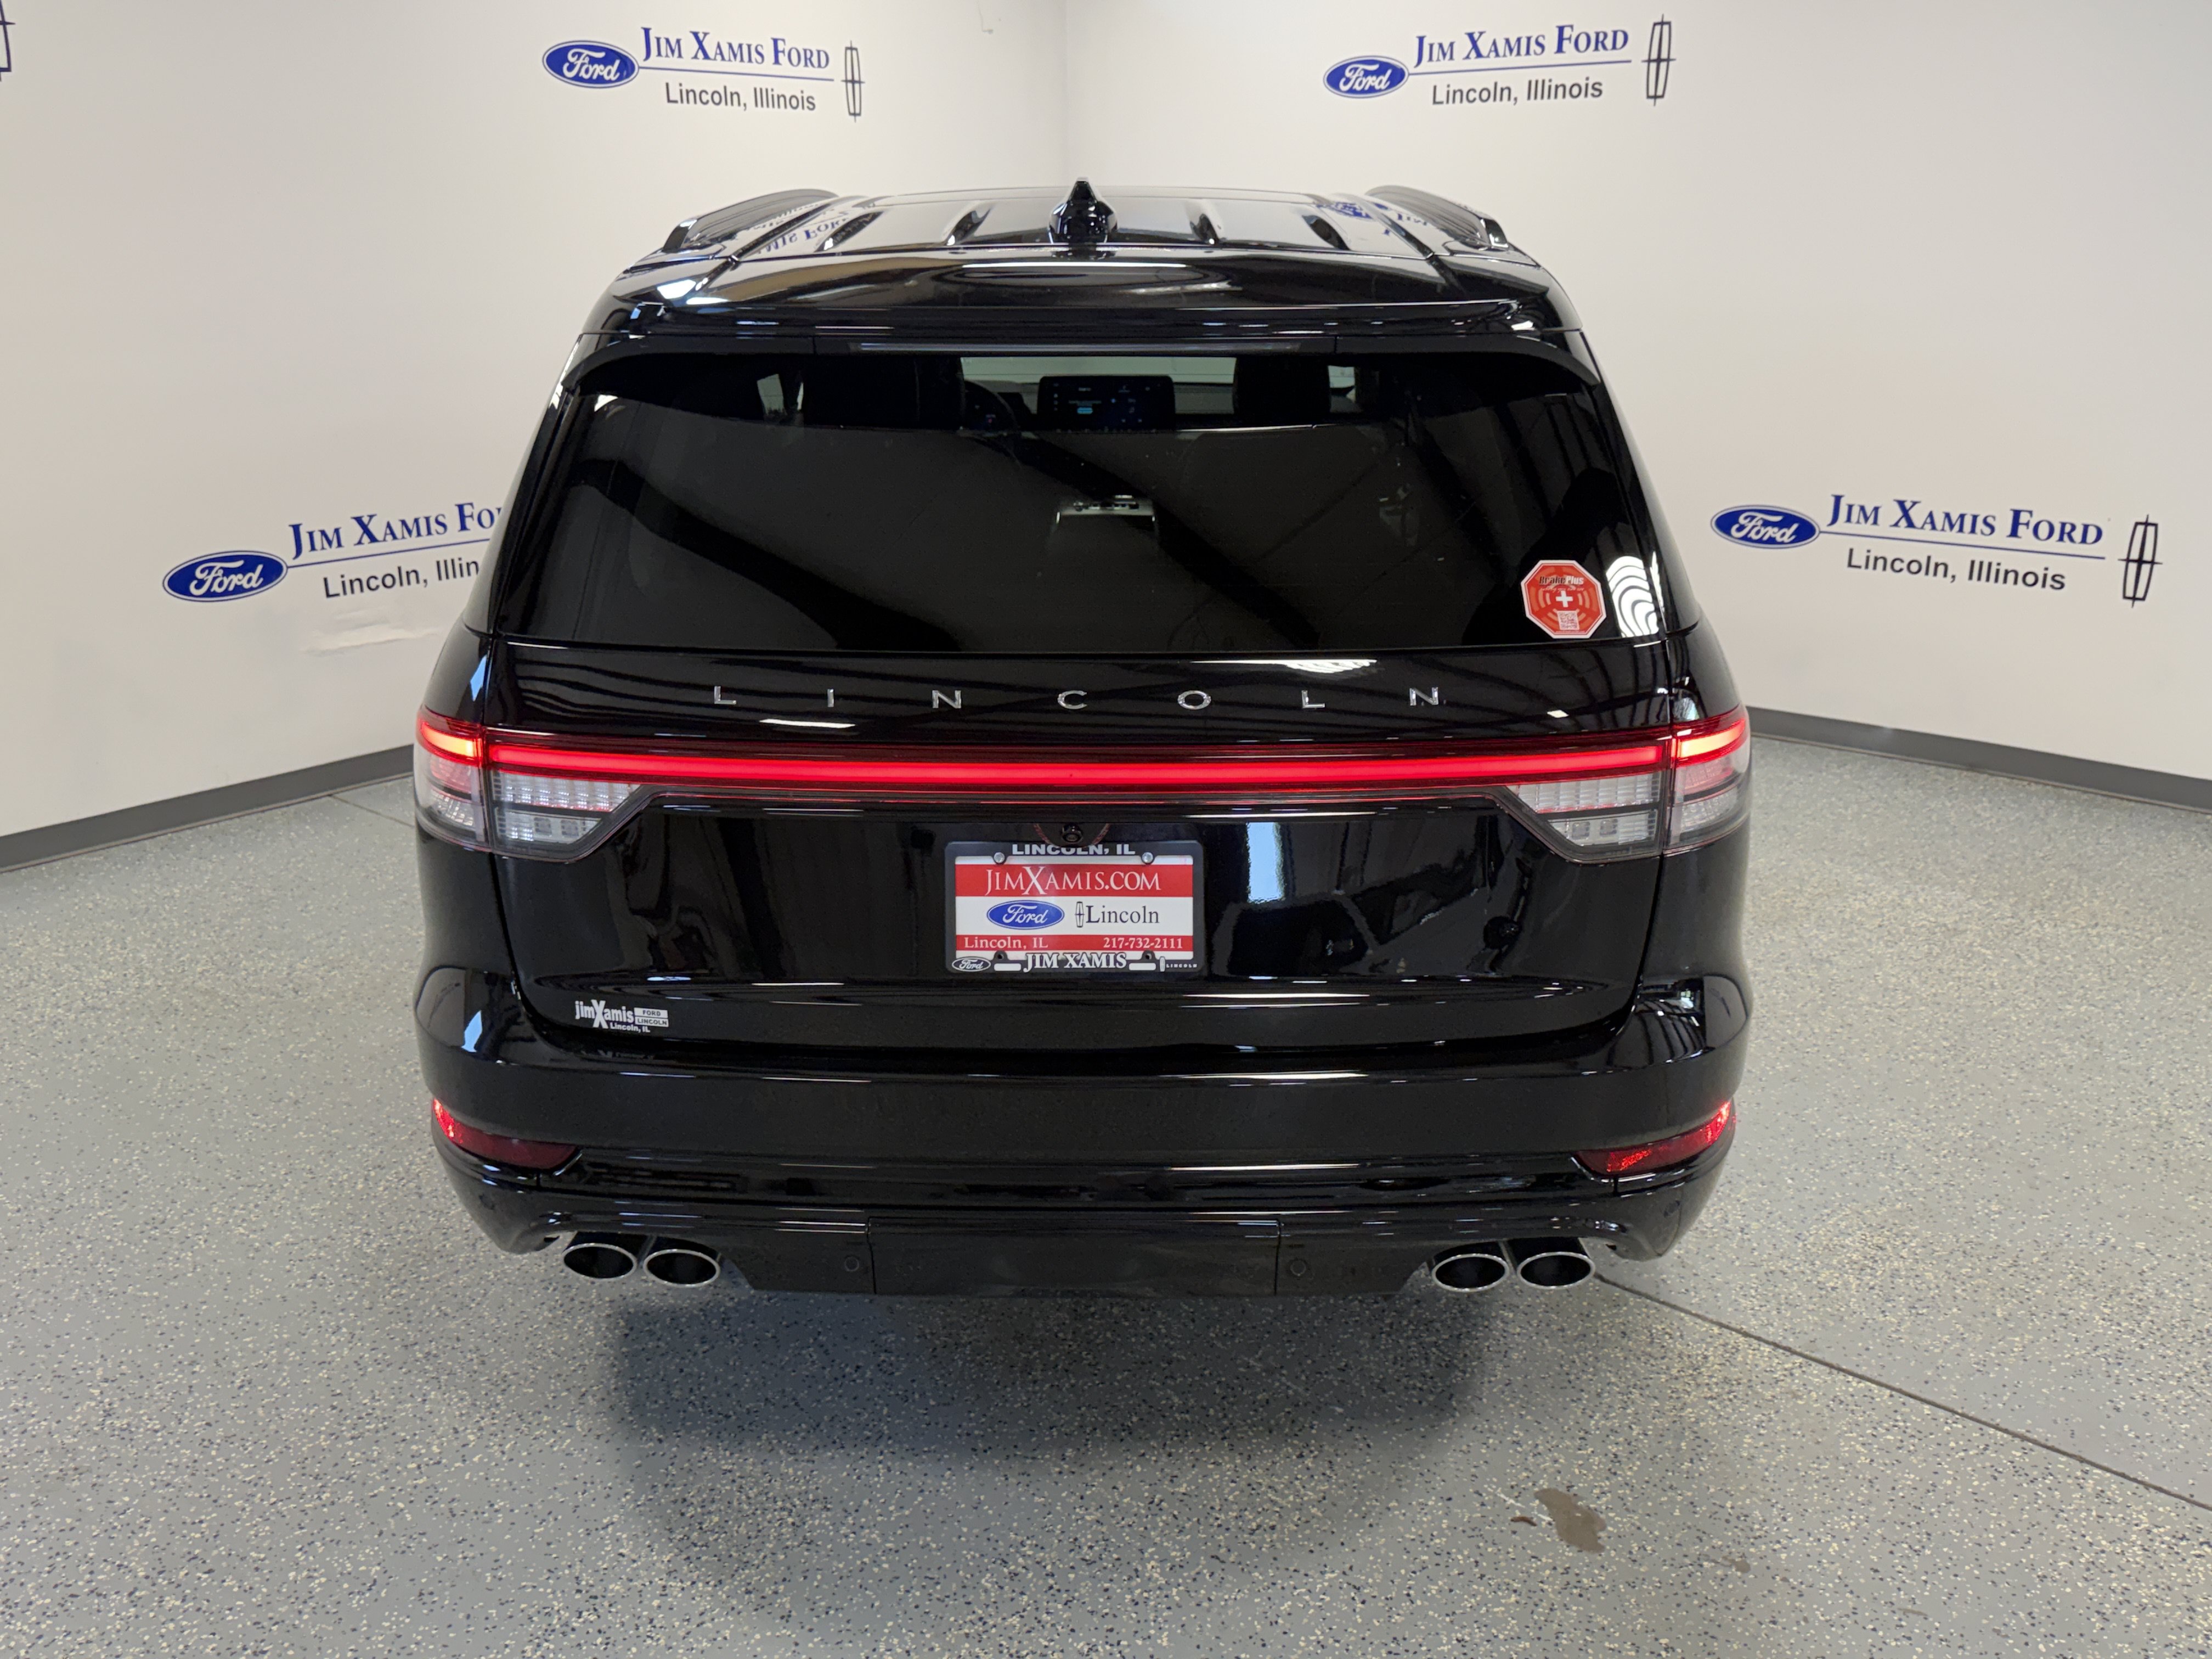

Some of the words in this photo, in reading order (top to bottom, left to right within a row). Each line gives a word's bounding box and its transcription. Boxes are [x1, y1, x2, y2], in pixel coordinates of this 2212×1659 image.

[641, 26, 684, 62] JIM
[689, 31, 765, 65] XAMIS
[770, 37, 830, 69] FORD
[1414, 35, 1455, 68] JIM
[1463, 30, 1546, 60] XAMIS
[1554, 24, 1629, 54] FORD
[562, 48, 620, 81] Ford
[1338, 63, 1391, 92] Ford
[665, 82, 747, 111] Lincoln,
[754, 87, 816, 111] Illinois
[1432, 80, 1519, 105] Lincoln,
[1526, 77, 1603, 101] Illinois
[288, 523, 345, 560] JIM
[351, 514, 448, 546] XAMIS
[455, 503, 501, 532] FO
[1730, 512, 1796, 545] Ford
[1826, 493, 1882, 528] JIM
[1891, 499, 1996, 537] XAMIS
[2006, 508, 2103, 546] FORD
[188, 559, 264, 596] Ford
[323, 565, 428, 599] Lincoln,
[436, 557, 479, 582] Illin
[1539, 575, 1584, 585] BrakePlus
[1846, 548, 1957, 584] Lincoln,
[1967, 559, 2066, 591] Illinois
[714, 686, 1438, 709] LINCOLN
[1116, 844, 1136, 855] IL
[1003, 903, 1048, 924] Ford
[1086, 905, 1160, 924] Lincoln
[964, 937, 1026, 950] Lincoln,
[1032, 937, 1048, 949] IL
[1103, 937, 1182, 949] 217-732-2111
[958, 959, 984, 970] Ford
[1023, 952, 1059, 973] JIM
[1064, 952, 1127, 969] XAMIS
[610, 1022, 641, 1033] Lincoln,
